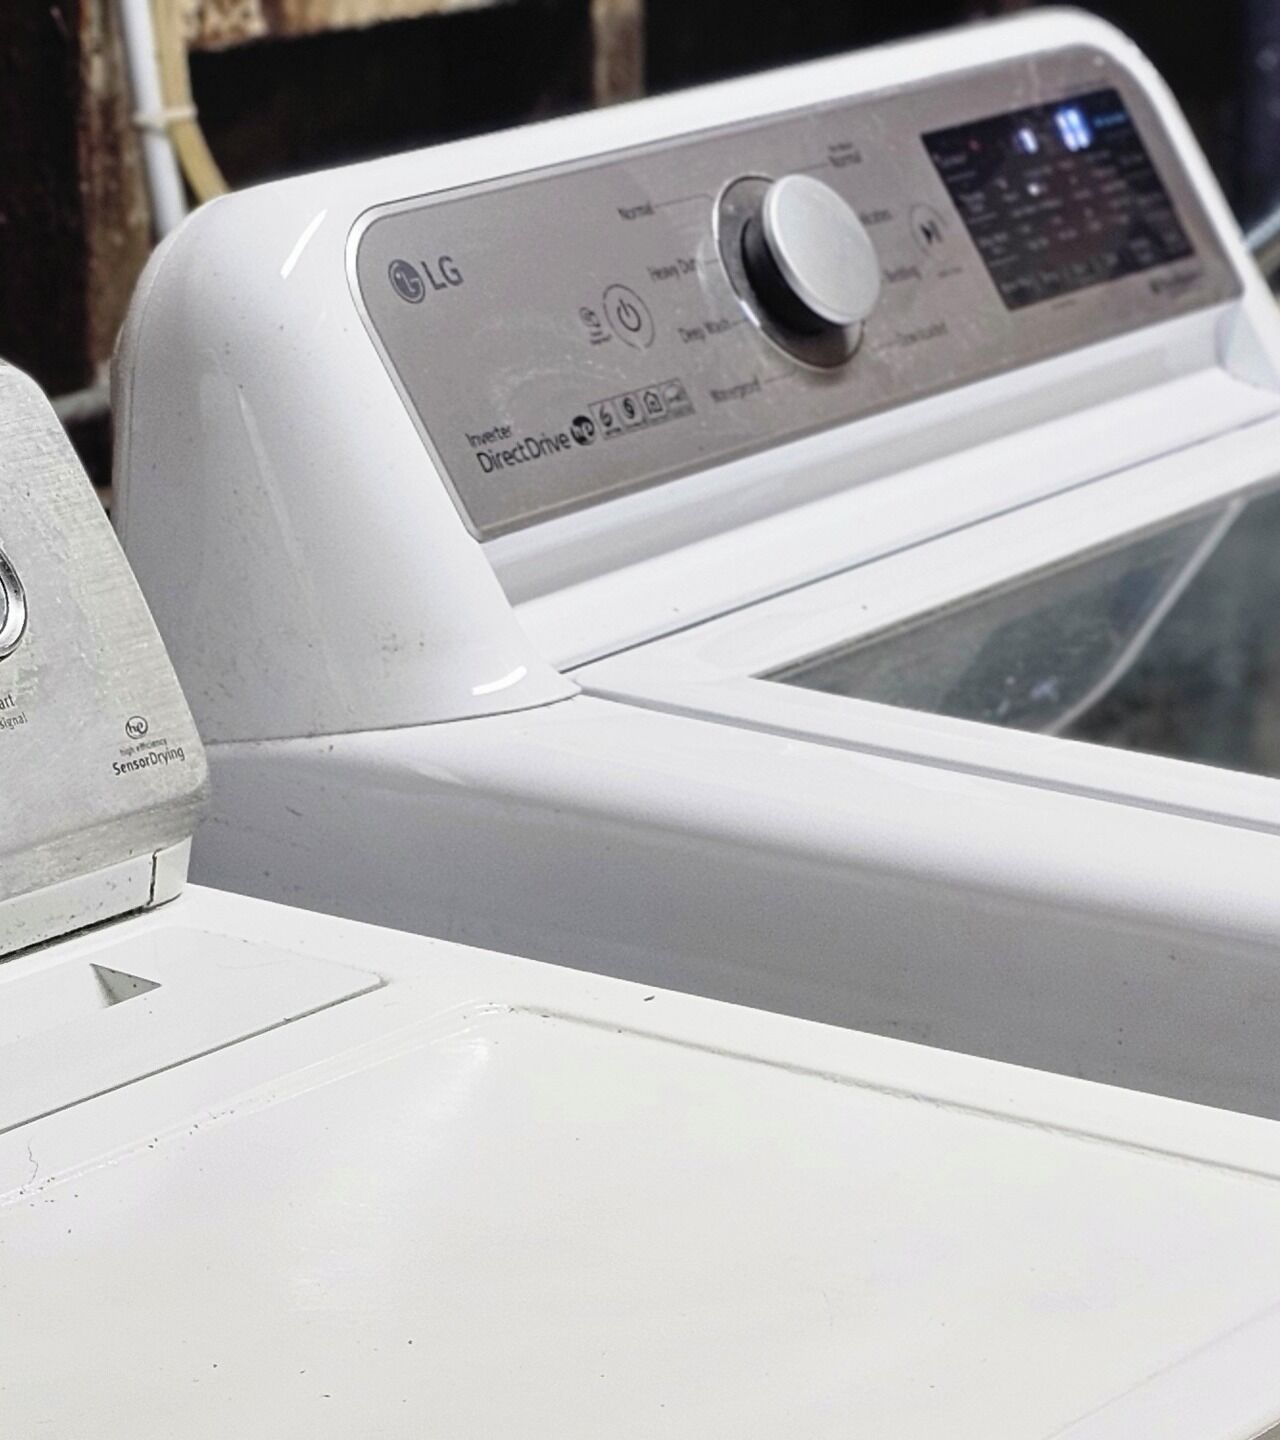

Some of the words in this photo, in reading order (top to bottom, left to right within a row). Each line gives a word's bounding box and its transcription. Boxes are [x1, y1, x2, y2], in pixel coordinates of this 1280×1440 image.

[420, 255, 464, 290] LG
[465, 424, 512, 449] Inverter
[0, 711, 29, 730] signal
[112, 746, 186, 776] SensorDrying
